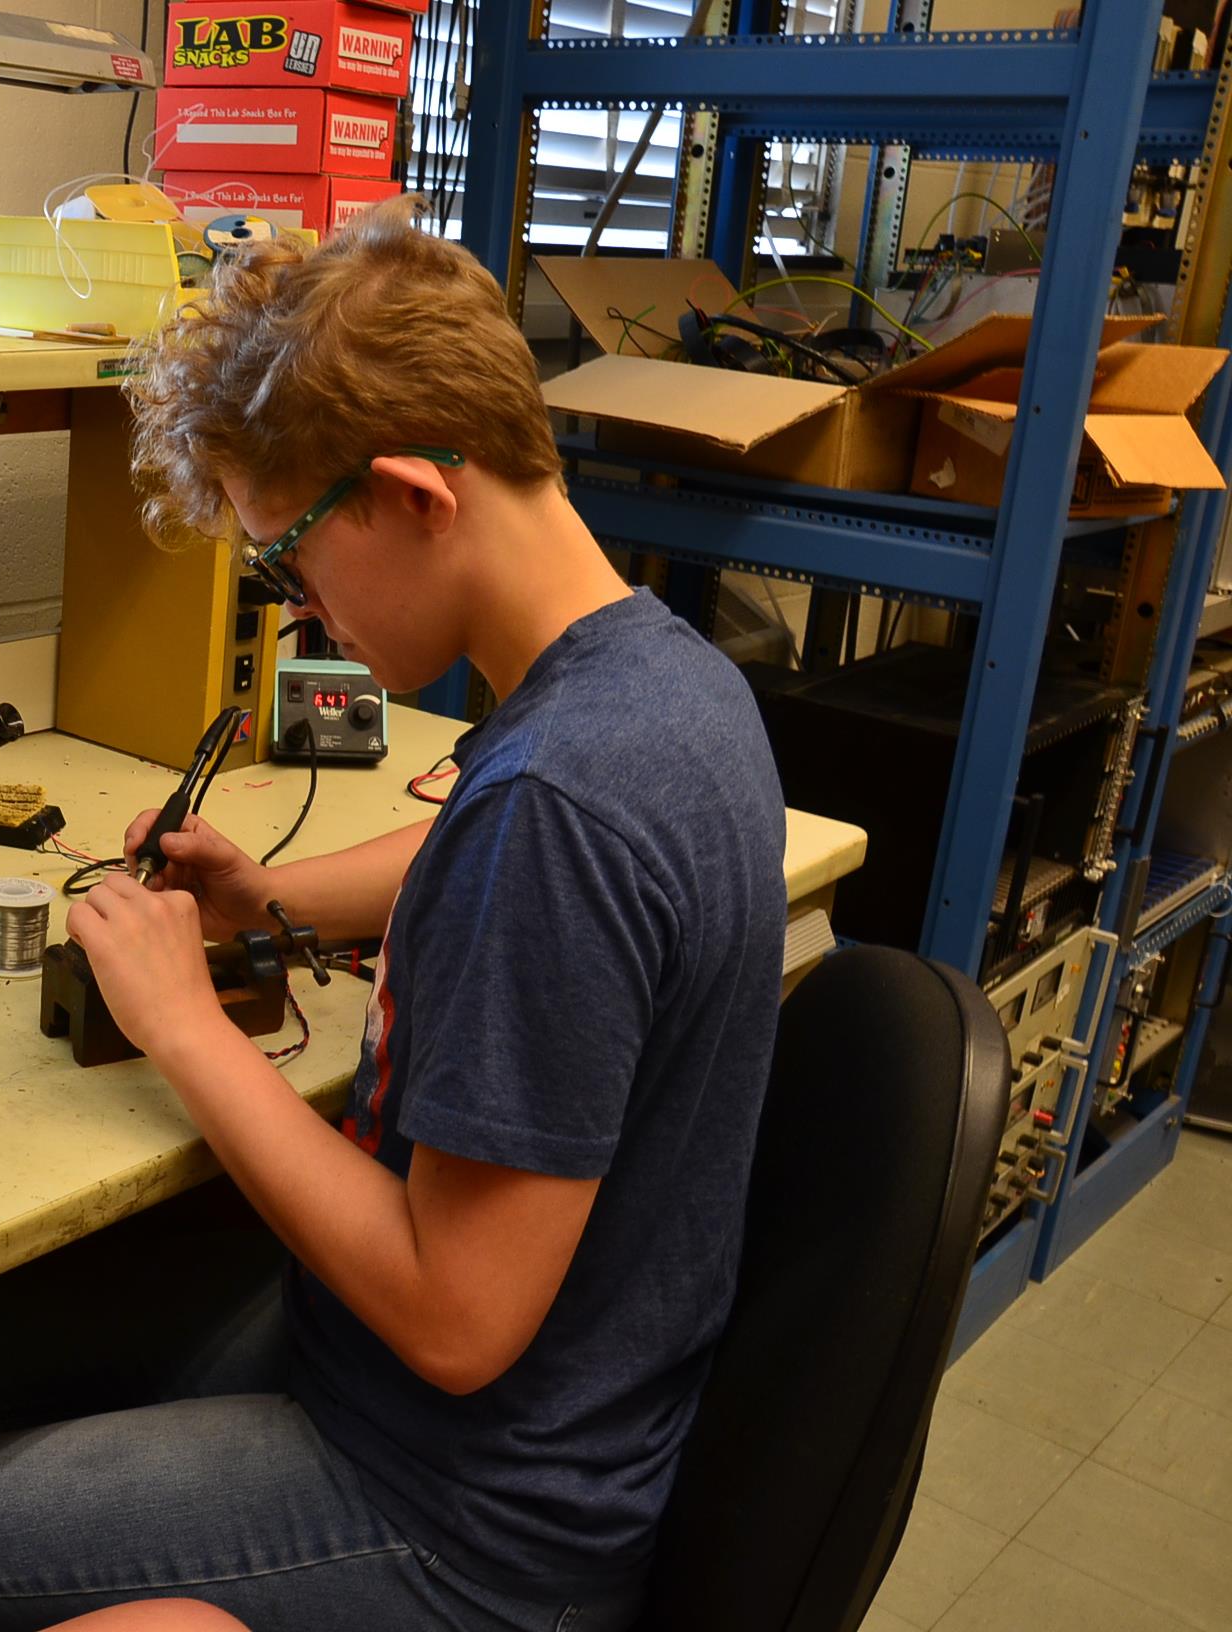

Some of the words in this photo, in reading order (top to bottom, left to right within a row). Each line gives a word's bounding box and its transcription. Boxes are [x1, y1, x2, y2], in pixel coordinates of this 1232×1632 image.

[175, 15, 288, 53] LAB
[341, 33, 400, 60] WARNING
[174, 49, 249, 68] SNACKS
[210, 108, 225, 117] This
[227, 108, 239, 117] Lab
[241, 108, 265, 117] Snacks
[267, 108, 282, 118] Box
[284, 108, 297, 118] For
[334, 120, 385, 141] WARNING
[216, 191, 232, 201] This
[234, 191, 245, 201] Lab
